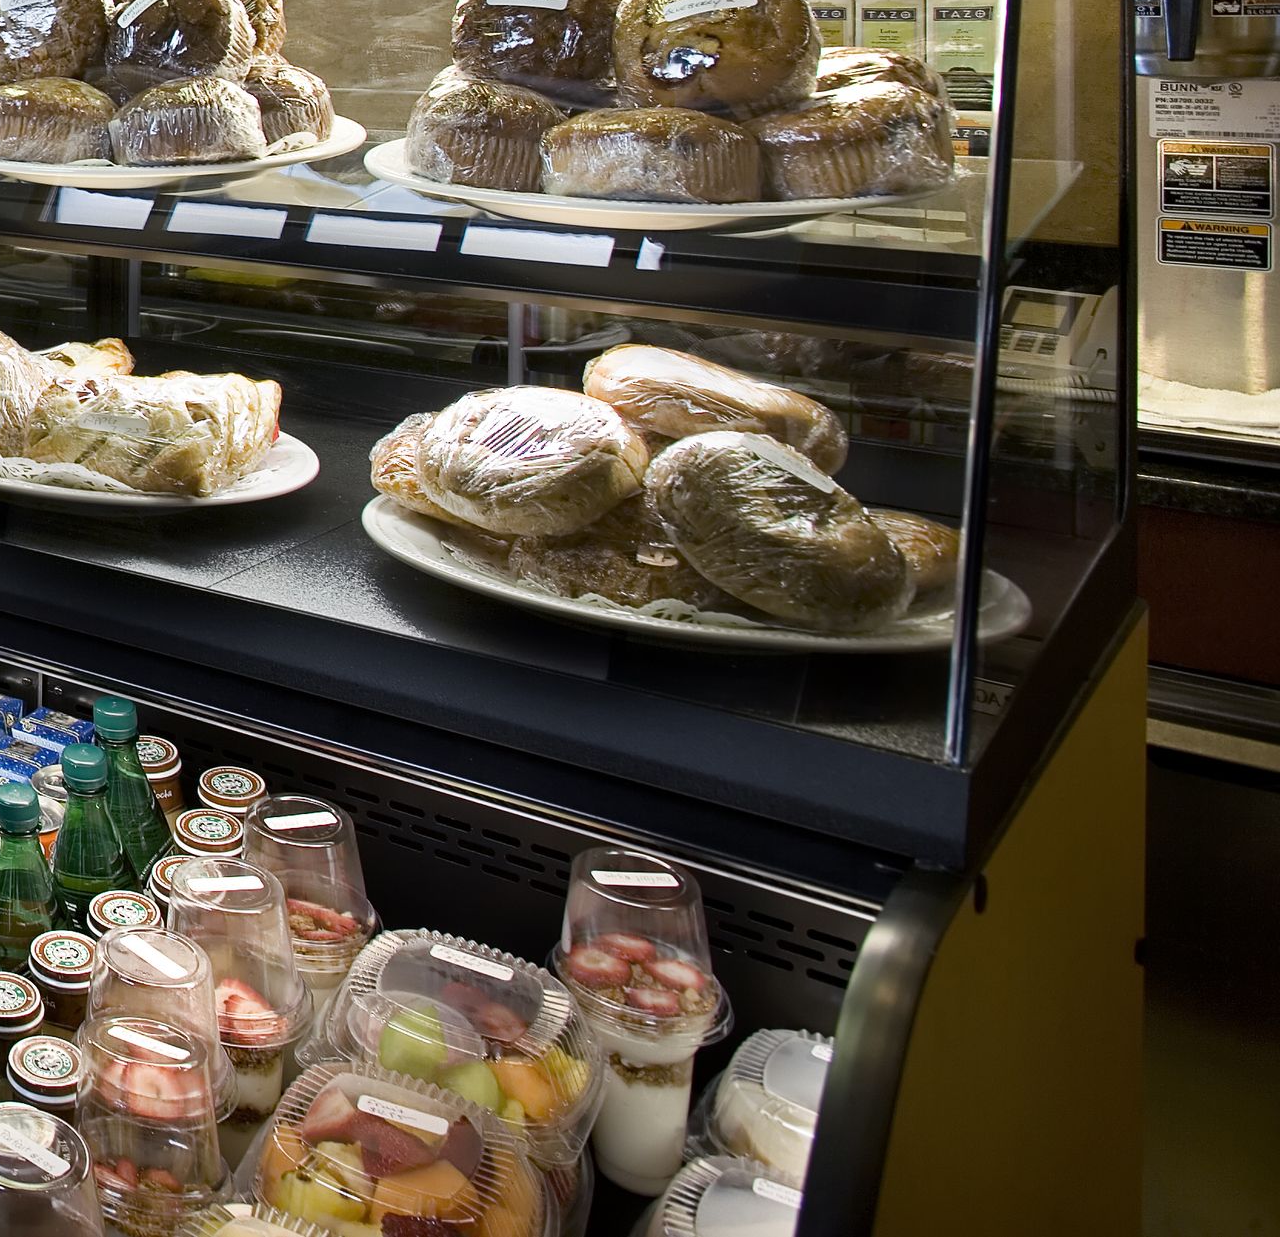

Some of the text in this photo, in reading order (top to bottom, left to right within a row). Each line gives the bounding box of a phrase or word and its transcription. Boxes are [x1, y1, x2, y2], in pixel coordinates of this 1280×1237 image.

[867, 11, 911, 19] TAZO
[939, 9, 985, 18] TAZO
[1160, 83, 1198, 92] BUNN
[1194, 223, 1250, 234] WARNING
